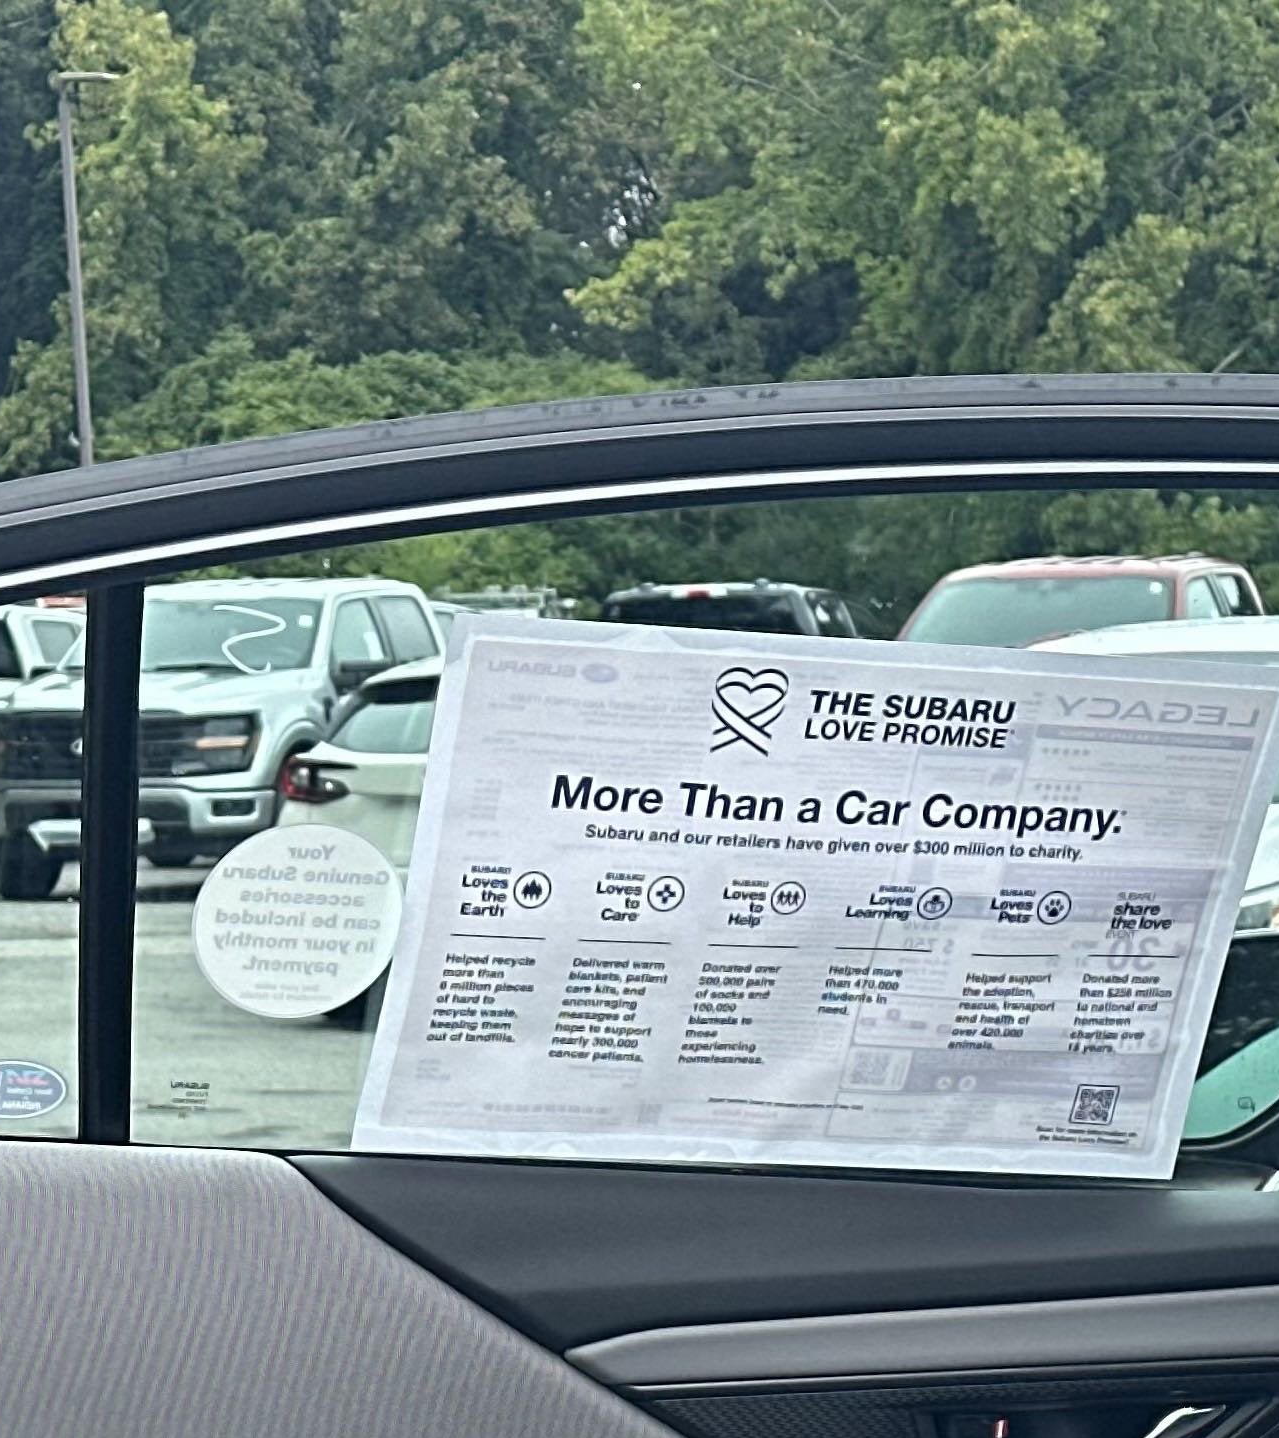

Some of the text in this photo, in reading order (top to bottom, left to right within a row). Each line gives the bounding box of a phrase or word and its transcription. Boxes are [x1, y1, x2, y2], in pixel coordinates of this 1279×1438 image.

[810, 689, 1016, 724] THE SUBARU
[804, 719, 1009, 749] LOVE PROMISE
[551, 774, 1122, 841] More Than a Car Company.
[585, 824, 1082, 862] Subaru and our retailers have given over $300 million to charity.
[461, 875, 508, 889] Loves
[596, 881, 643, 896] Loves
[723, 888, 767, 901] Loves
[481, 890, 507, 903] the
[869, 894, 913, 906] Loves
[625, 897, 640, 909] to
[750, 902, 764, 913] to
[991, 898, 1034, 911] Loves
[1114, 902, 1160, 916] share
[460, 903, 505, 918] Earth
[601, 909, 637, 922] Care
[845, 906, 909, 920] Learning
[728, 913, 761, 928] Help
[998, 912, 1031, 924] Pets
[1111, 916, 1172, 930] the love
[445, 953, 536, 967] Helped recycle
[572, 958, 665, 970] Delivered warm
[443, 969, 505, 979] more than
[702, 962, 782, 974] Donated over
[829, 965, 903, 977] Helped more
[966, 972, 1052, 985] Helped support
[1083, 973, 1160, 984] Donated more
[450, 981, 491, 992] million
[566, 985, 591, 994] care
[622, 986, 646, 996] and
[963, 987, 980, 997] the
[436, 994, 495, 1005] of hard to
[694, 989, 709, 1000] of
[748, 990, 771, 1000] and
[821, 992, 887, 1004] students in
[562, 999, 637, 1011] encouraging
[622, 1012, 636, 1022] of
[955, 1014, 976, 1024] and
[1018, 1015, 1030, 1024] of
[588, 1024, 601, 1033] to
[604, 1026, 652, 1037] support
[952, 1028, 978, 1037] over
[426, 1032, 446, 1042] out
[450, 1033, 464, 1042] of
[681, 1041, 756, 1053] experiencing
